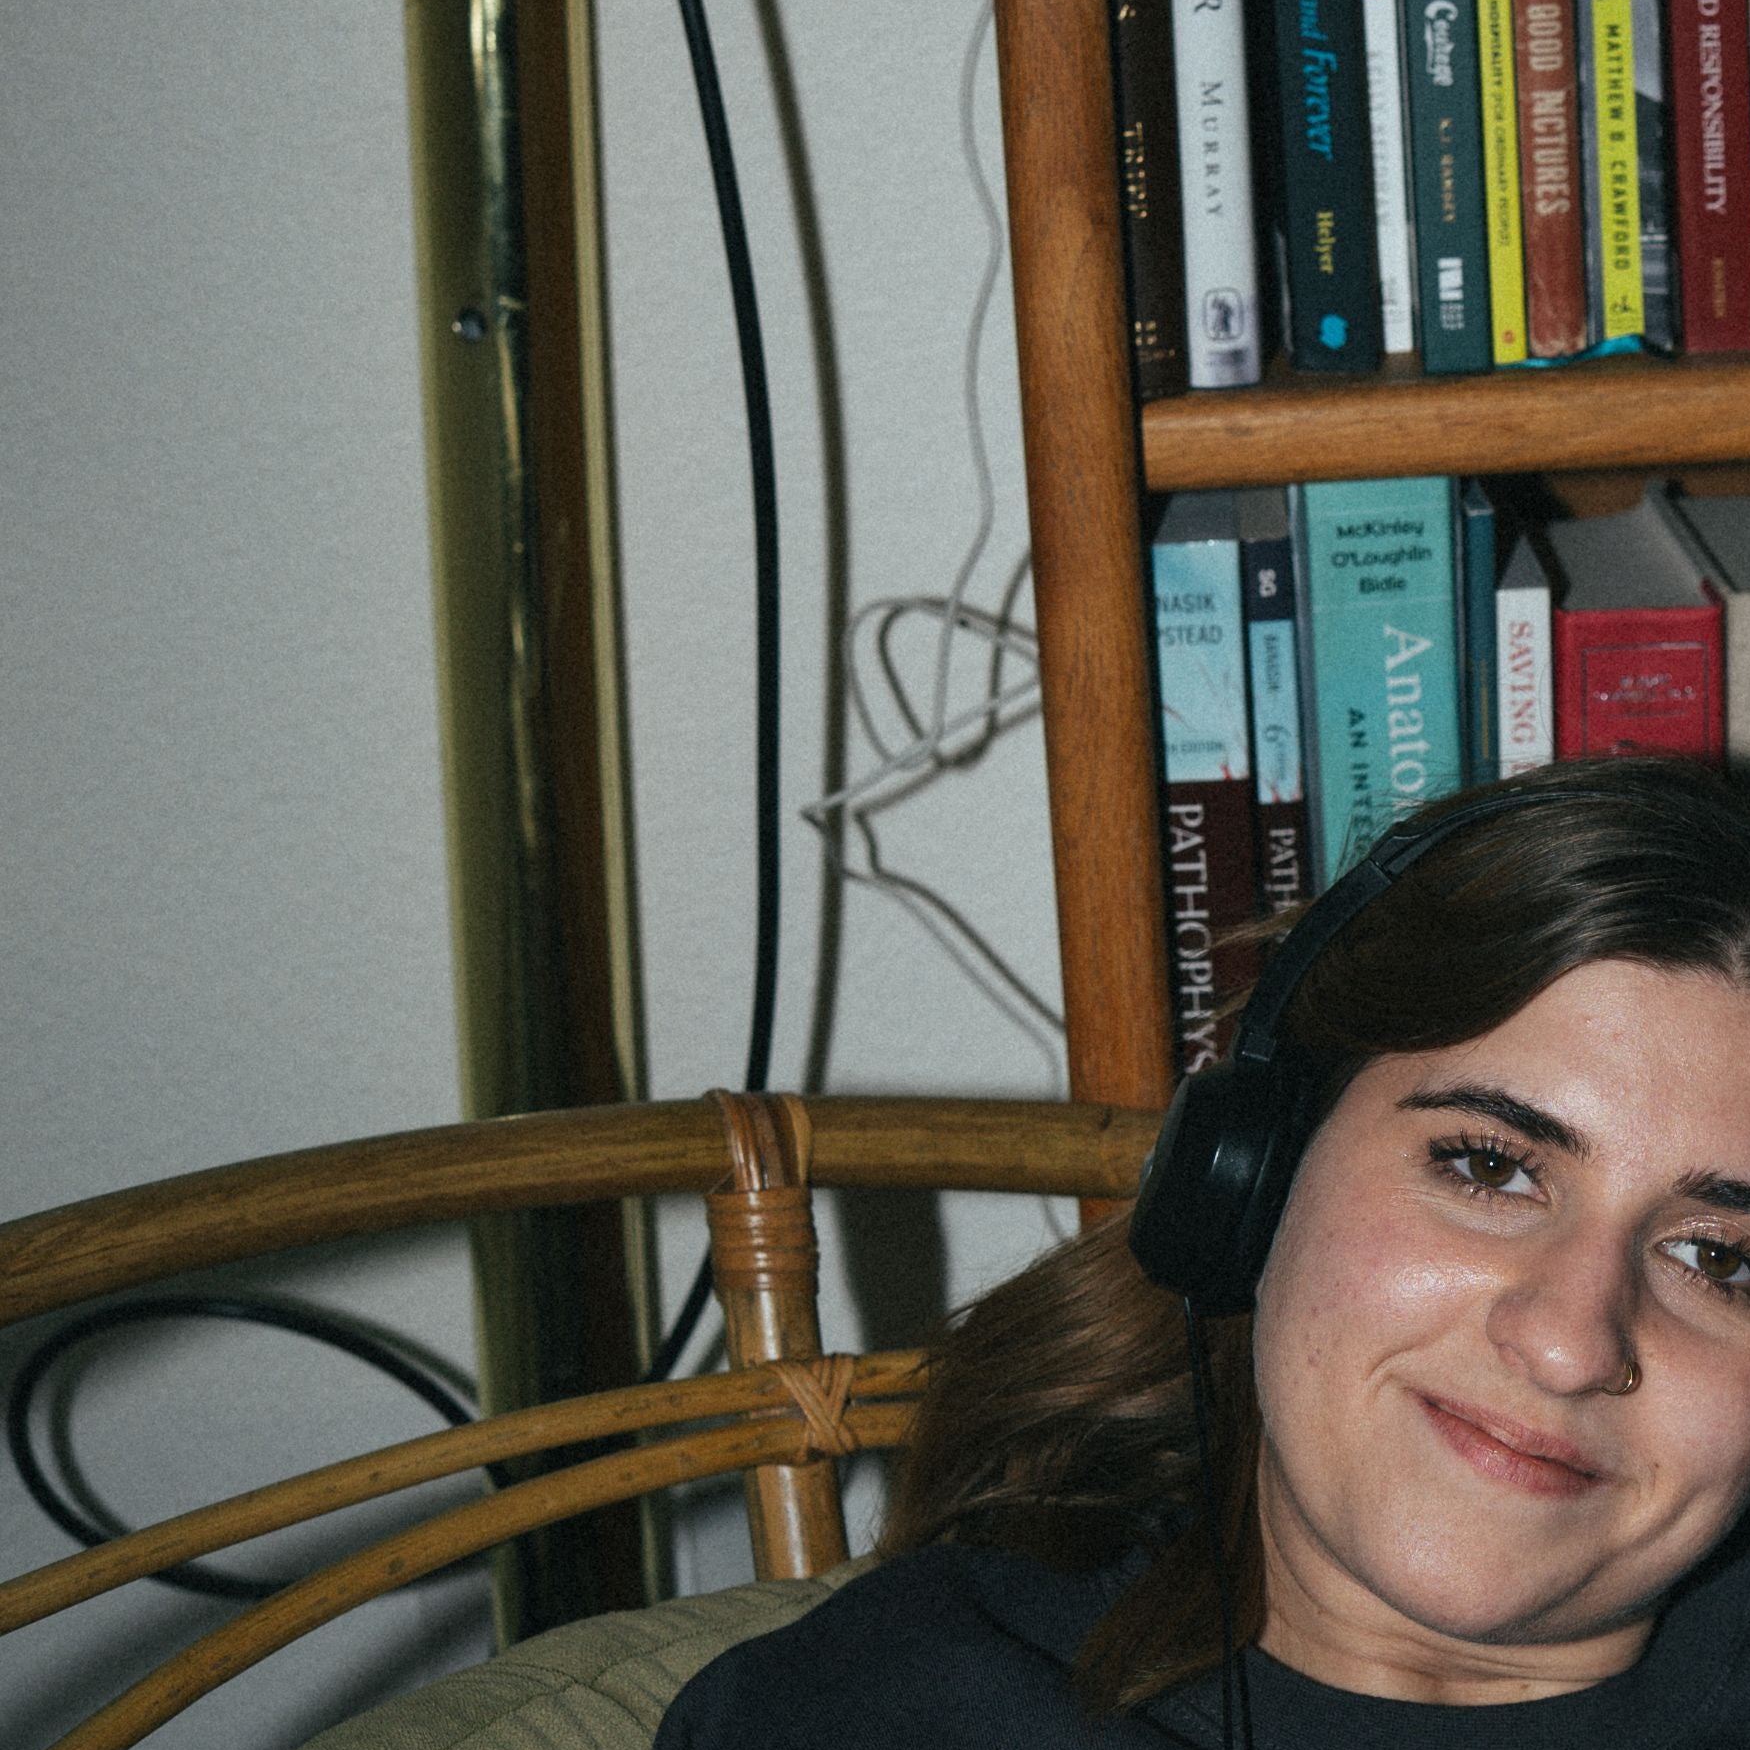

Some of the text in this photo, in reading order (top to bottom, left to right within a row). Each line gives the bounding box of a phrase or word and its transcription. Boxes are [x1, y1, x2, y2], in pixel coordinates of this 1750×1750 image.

[1424, 0, 1458, 88] Courage
[1526, 2, 1564, 72] GOOD
[1605, 24, 1624, 121] MATTHEW
[1199, 80, 1224, 218] MURRAY
[1301, 50, 1338, 160] Forever
[1698, 23, 1726, 216] RESPONSIBILITY
[1314, 210, 1336, 276] Helyer
[1610, 160, 1630, 272] CRAWFORD
[1334, 518, 1424, 541] McKinley
[1382, 624, 1434, 812] Anato
[1508, 620, 1536, 745] SAVING
